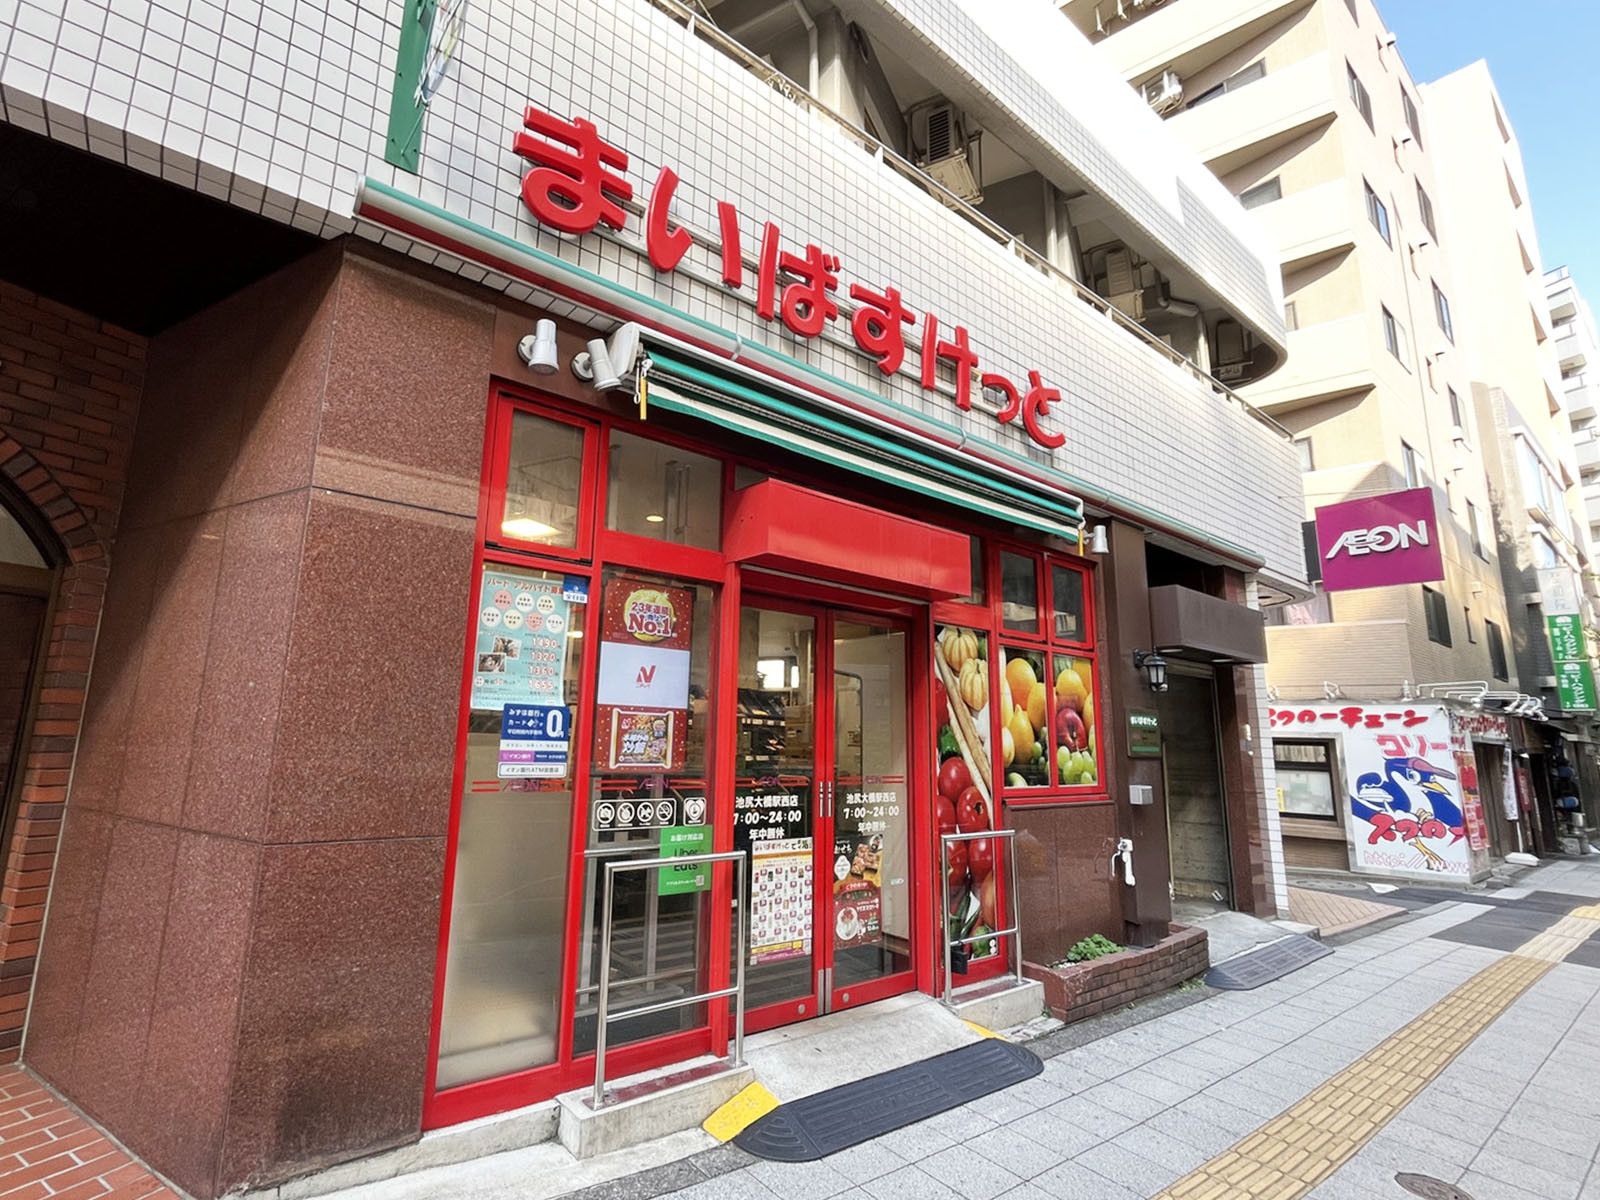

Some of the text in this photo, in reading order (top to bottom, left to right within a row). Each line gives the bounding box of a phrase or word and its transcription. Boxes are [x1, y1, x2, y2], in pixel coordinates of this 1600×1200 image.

[513, 105, 1066, 449] まいばすけっと
[1325, 520, 1429, 560] AEON
[628, 612, 672, 635] No.1
